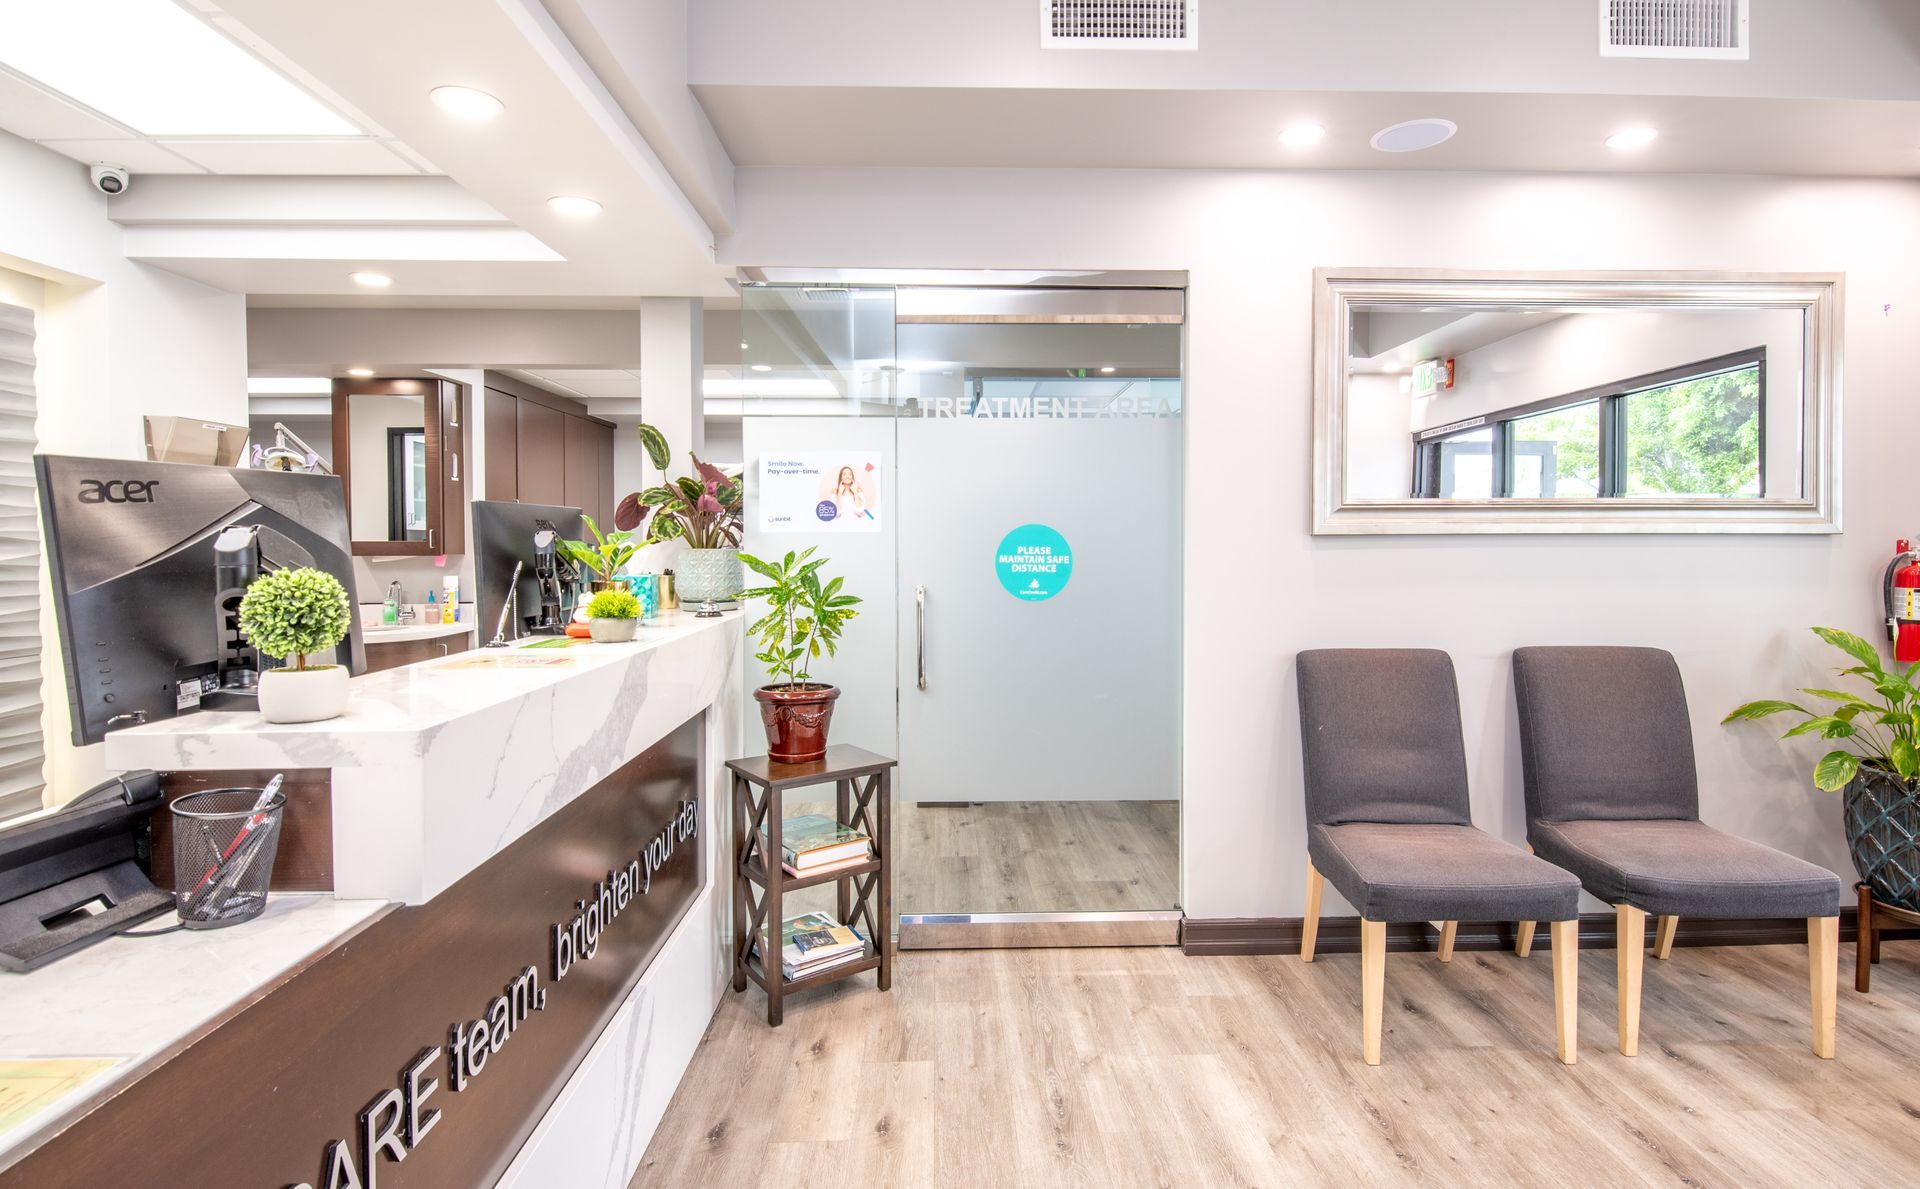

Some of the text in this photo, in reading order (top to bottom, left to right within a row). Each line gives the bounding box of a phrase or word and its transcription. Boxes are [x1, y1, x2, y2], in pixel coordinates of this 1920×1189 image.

[919, 396, 1174, 419] TREATMENT AREA
[78, 479, 159, 504] acer
[1017, 546, 1051, 555] PLEASE
[999, 555, 1070, 564] MAINTAIN SAFE
[1011, 564, 1057, 572] DISTANCE
[286, 799, 699, 1189] ARE team, brighten your day
